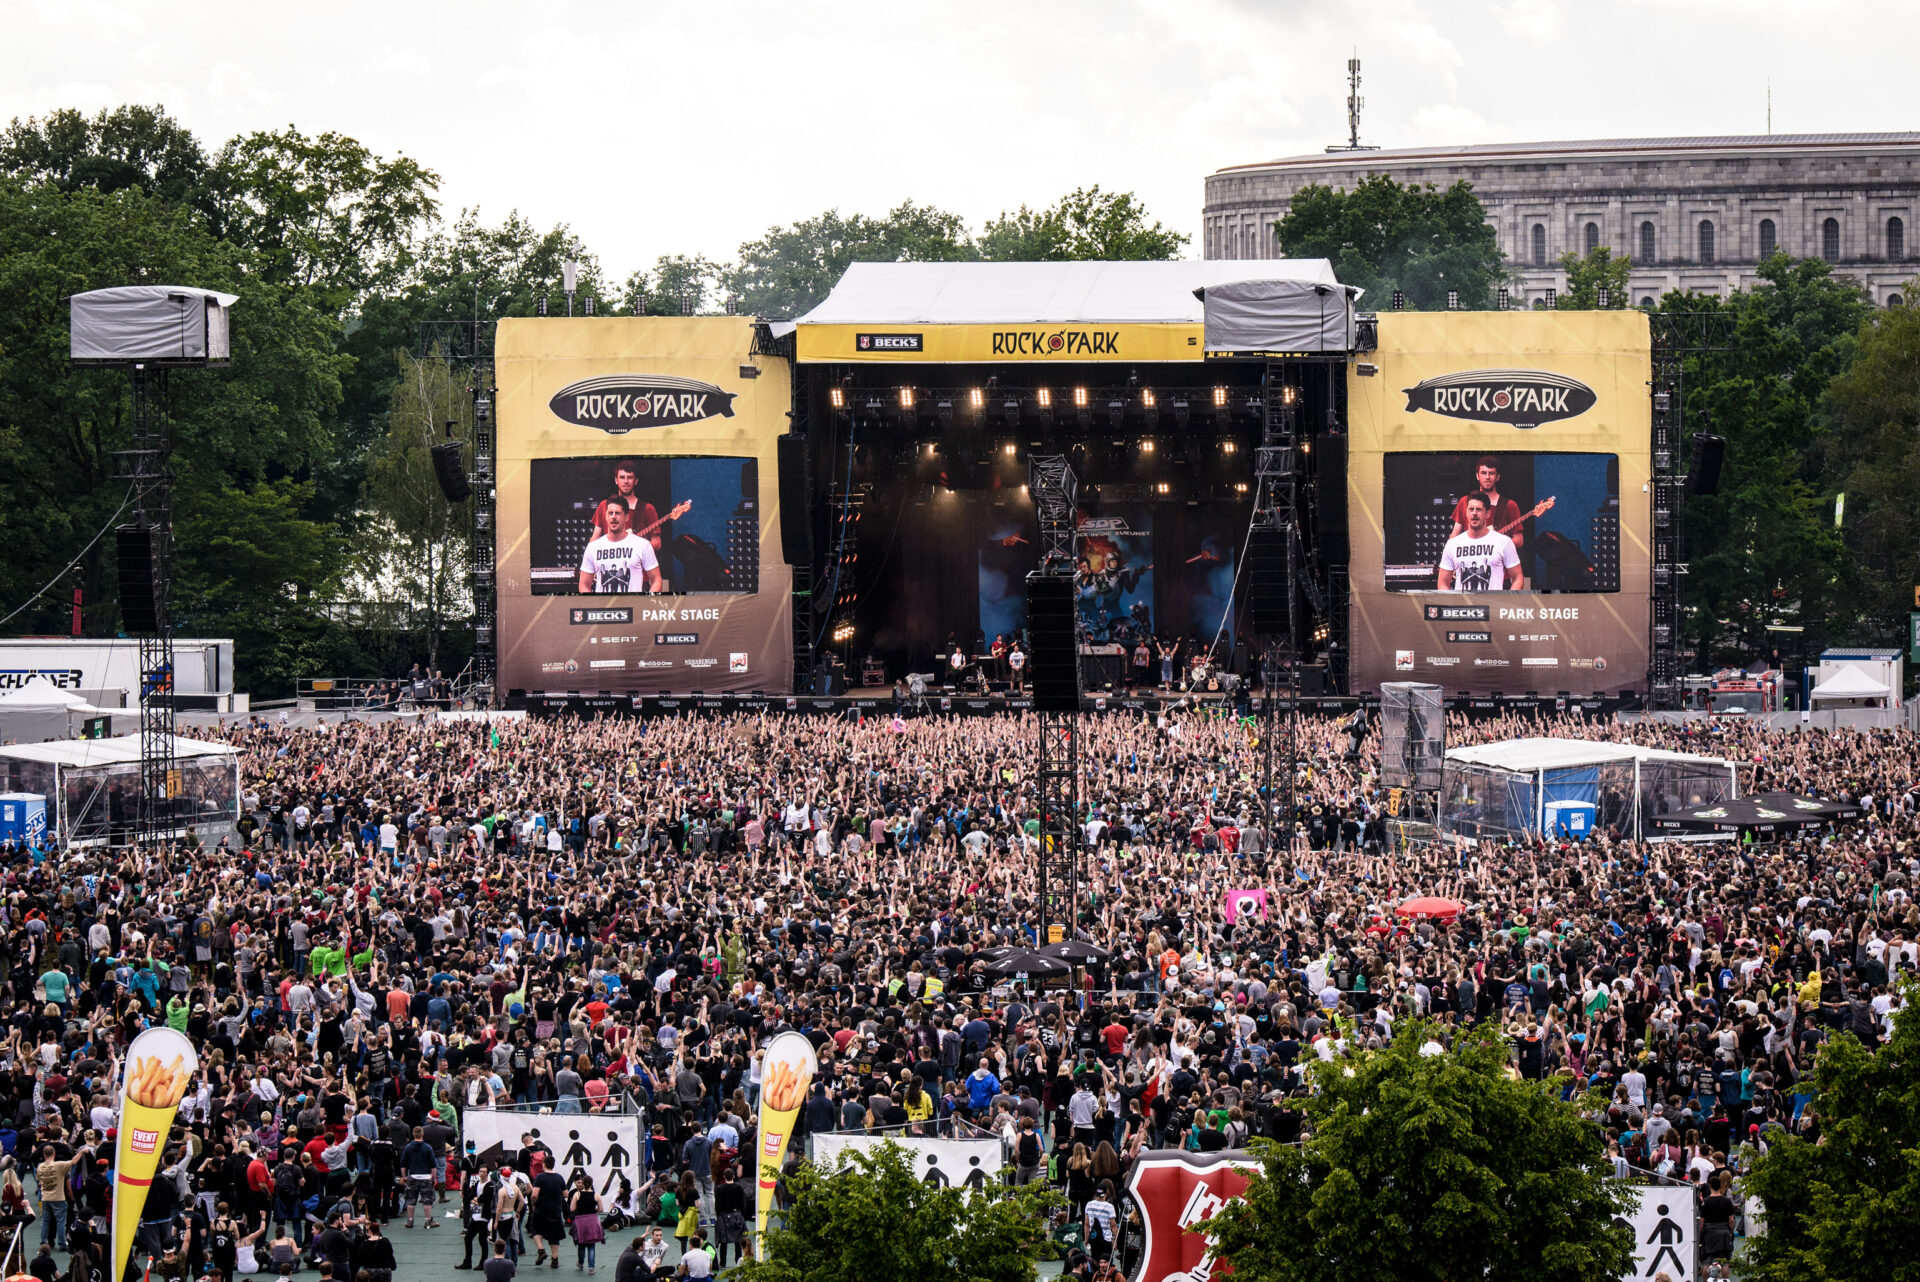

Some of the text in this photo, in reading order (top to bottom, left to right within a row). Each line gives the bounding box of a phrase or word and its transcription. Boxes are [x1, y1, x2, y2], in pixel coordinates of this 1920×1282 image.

[874, 337, 918, 347] BECK'S
[992, 331, 1119, 354] ROCK PARK
[577, 395, 631, 419] ROCK
[653, 394, 707, 418] PARK
[1435, 388, 1491, 411] ROCK
[1514, 388, 1569, 412] PARK
[1085, 519, 1122, 529] SDP
[596, 547, 633, 561] DBBDW
[1456, 544, 1494, 558] DBBDW
[587, 608, 719, 621] BECK'S PARK STAGE
[1442, 607, 1579, 620] BECK'S PARK STAGE
[667, 635, 696, 643] BECK'S
[1458, 632, 1488, 641] BECK'S
[1042, 1033, 1054, 1046] 23
[133, 1129, 158, 1143] EVENT
